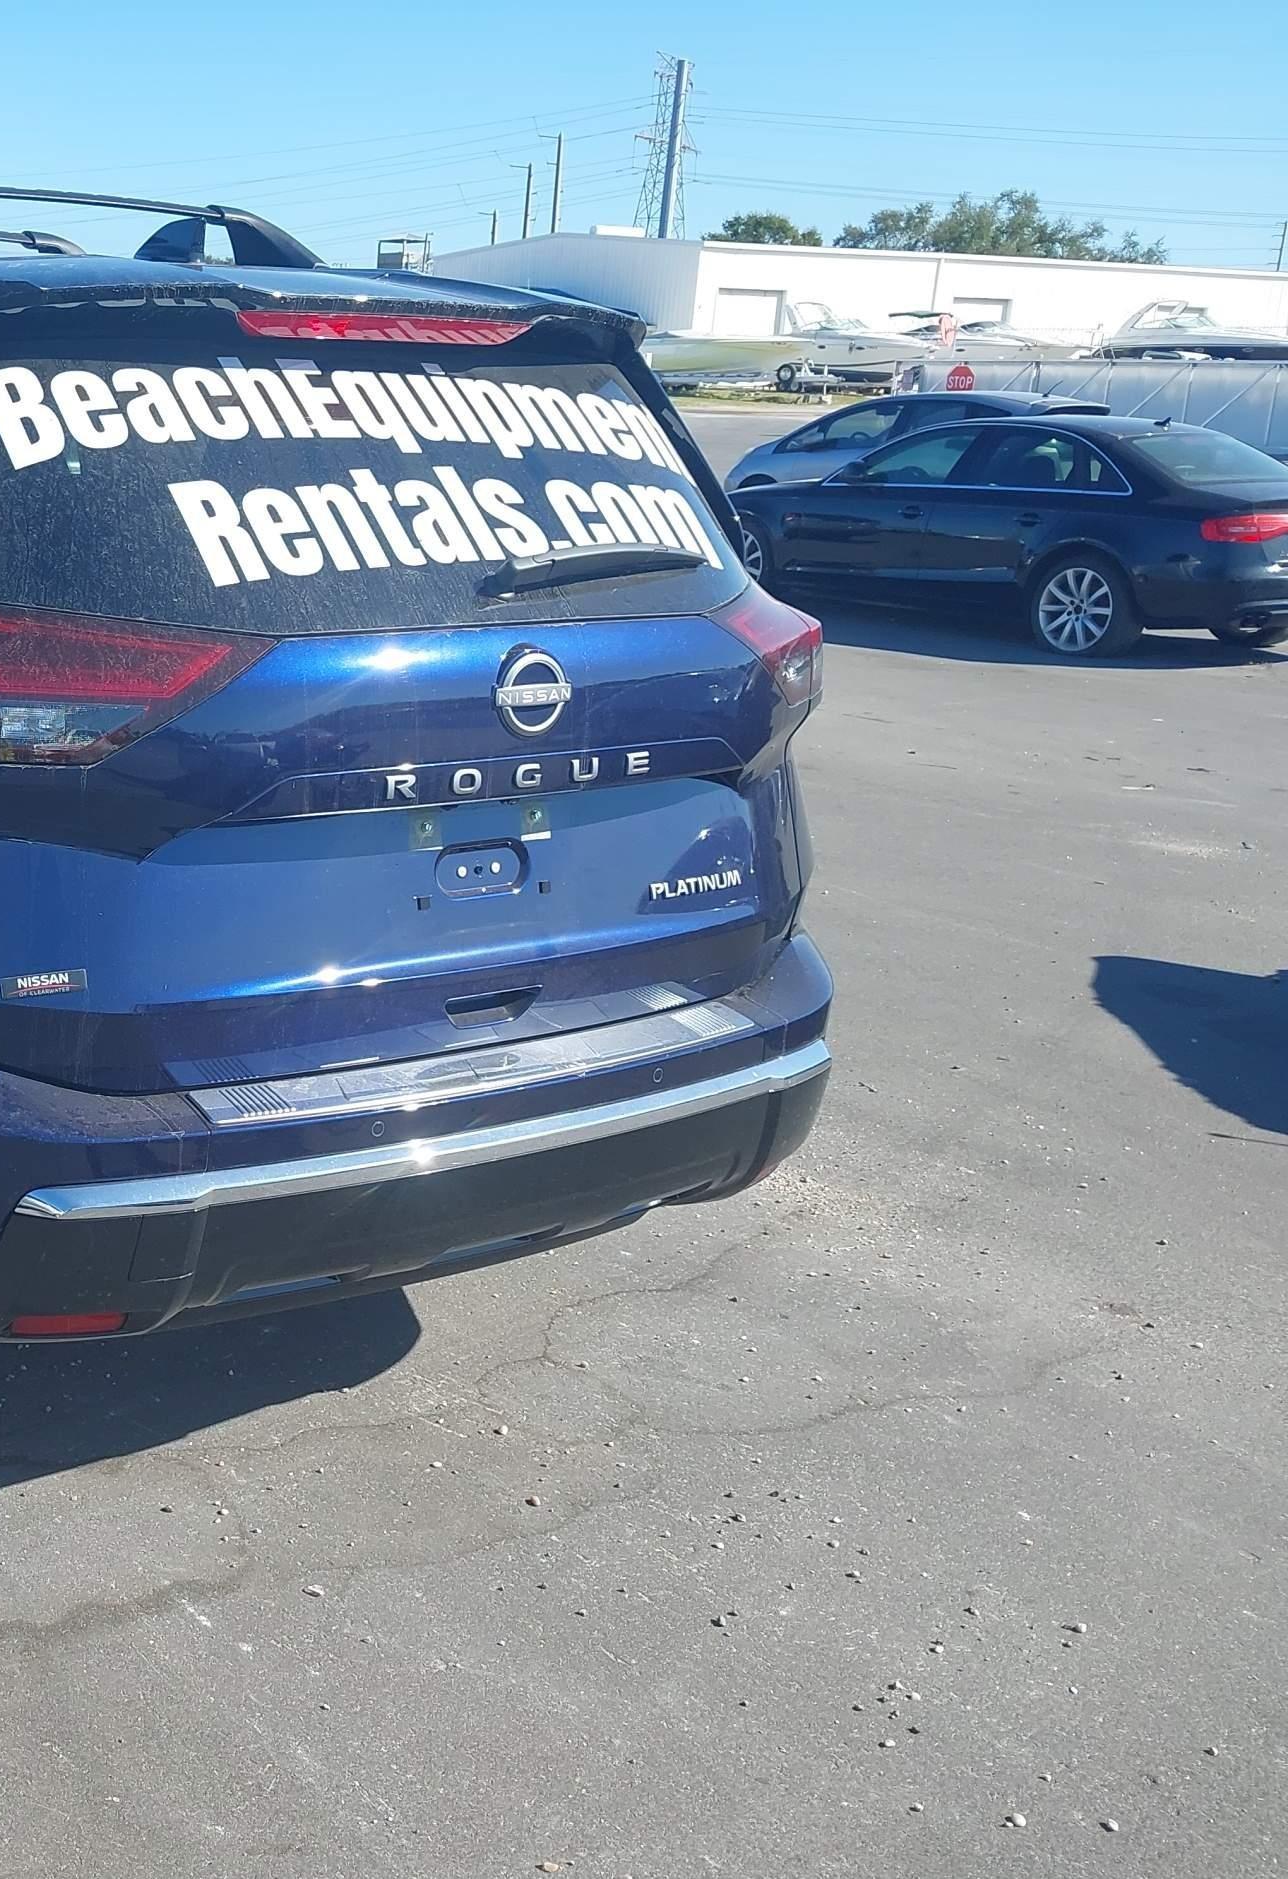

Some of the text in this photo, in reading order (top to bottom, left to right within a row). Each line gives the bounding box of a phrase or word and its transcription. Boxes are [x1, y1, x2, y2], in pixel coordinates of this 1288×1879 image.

[947, 375, 973, 389] STOP
[168, 466, 724, 587] Rentals.com
[498, 684, 571, 706] NISSAN
[386, 751, 650, 800] ROGUE
[650, 870, 742, 900] PLATINUM
[17, 973, 69, 989] NISSAN
[29, 986, 70, 996] CLEARWATER
